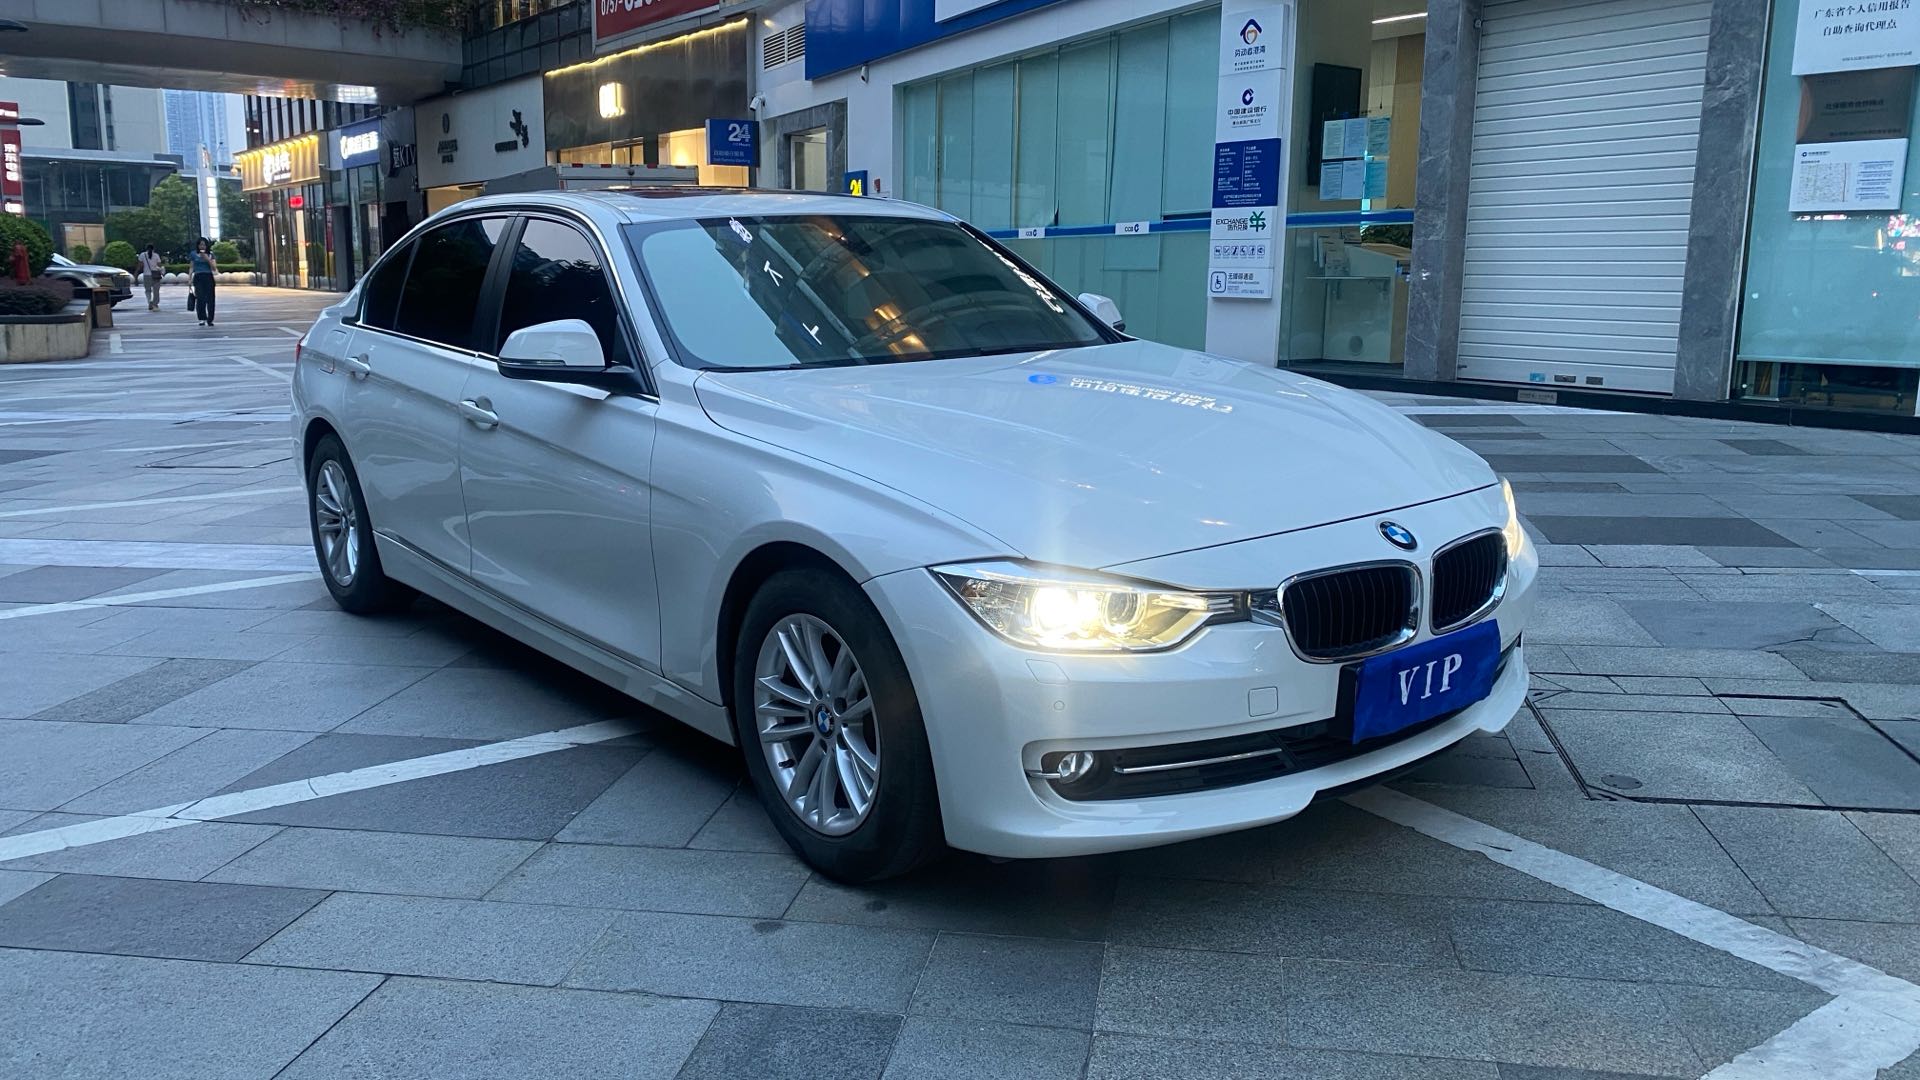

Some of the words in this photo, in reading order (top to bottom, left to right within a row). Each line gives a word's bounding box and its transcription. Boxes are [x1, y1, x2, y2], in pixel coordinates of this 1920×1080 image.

[1814, 0, 1911, 19] 广东省个人信用报告
[1823, 18, 1897, 36] 自助查询代理点
[1227, 106, 1267, 115] 中国建设银行
[728, 123, 751, 142] 24
[1216, 218, 1248, 226] EXCHANGE
[1398, 653, 1463, 705] VIP
